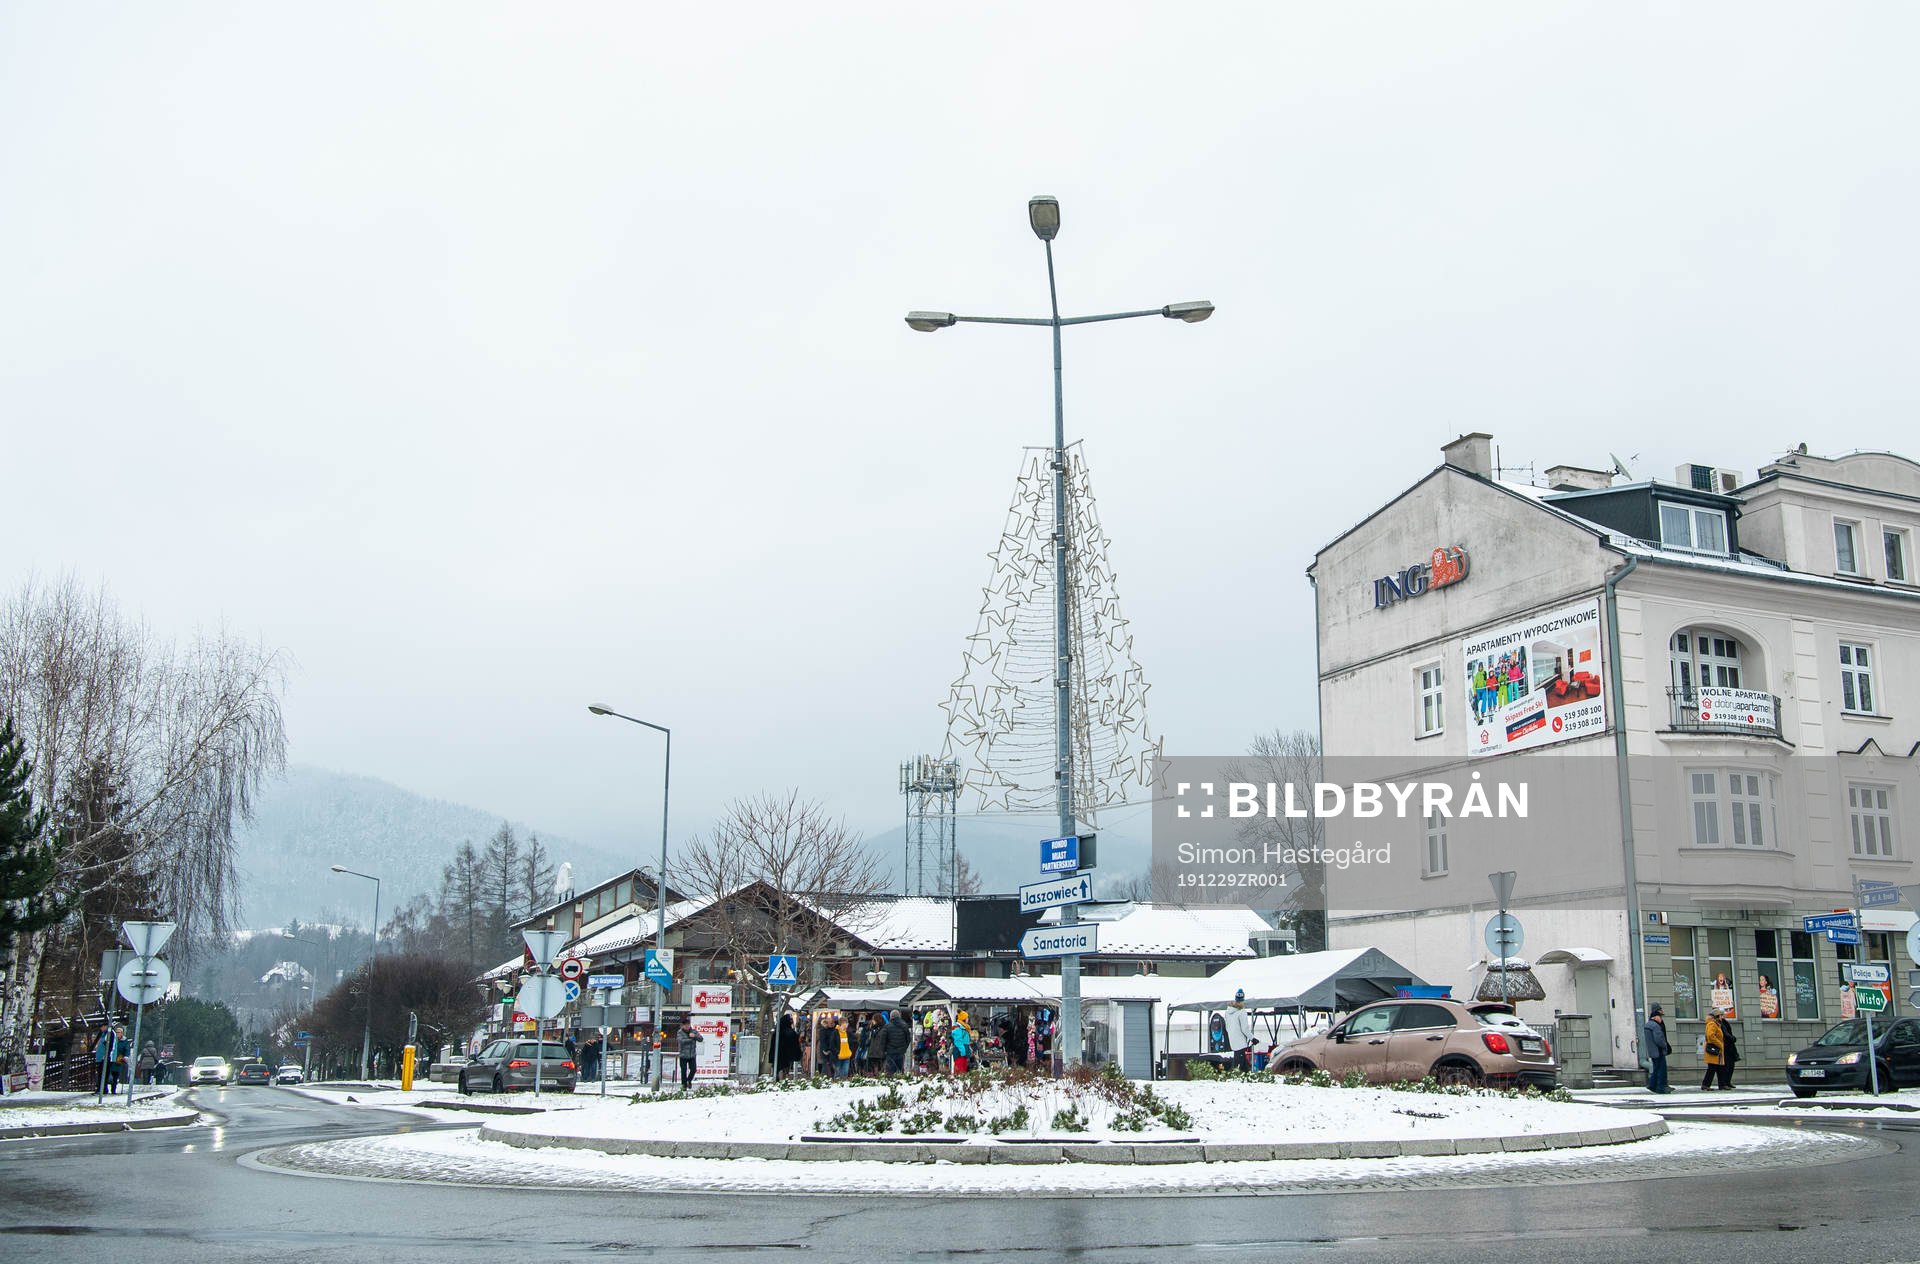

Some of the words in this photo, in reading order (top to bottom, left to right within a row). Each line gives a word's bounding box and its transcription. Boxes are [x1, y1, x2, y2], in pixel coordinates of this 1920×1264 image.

[1374, 563, 1428, 608] ING
[1466, 631, 1522, 656] APARTAMENTY
[1523, 608, 1598, 639] WYPOCZYNKOWE
[1701, 688, 1732, 697] WOLNE
[1505, 711, 1524, 723] Skipass
[1524, 704, 1535, 714] Free
[1535, 698, 1544, 709] Ski
[1564, 711, 1576, 721] 519
[1577, 707, 1589, 717] 308
[1590, 704, 1602, 714] 100
[1564, 722, 1577, 733] 519
[1577, 719, 1589, 729] 308
[1591, 716, 1602, 726] 101
[1051, 839, 1068, 850] RONDO
[1051, 851, 1067, 861] MIAST
[1042, 859, 1076, 871] PARTNERSKICH
[1022, 886, 1078, 906] Jaszowiec
[1033, 934, 1087, 951] Sanatoria
[1853, 968, 1871, 979] Policja
[700, 996, 726, 1005] Apteka
[696, 1025, 727, 1035] Drogeria
